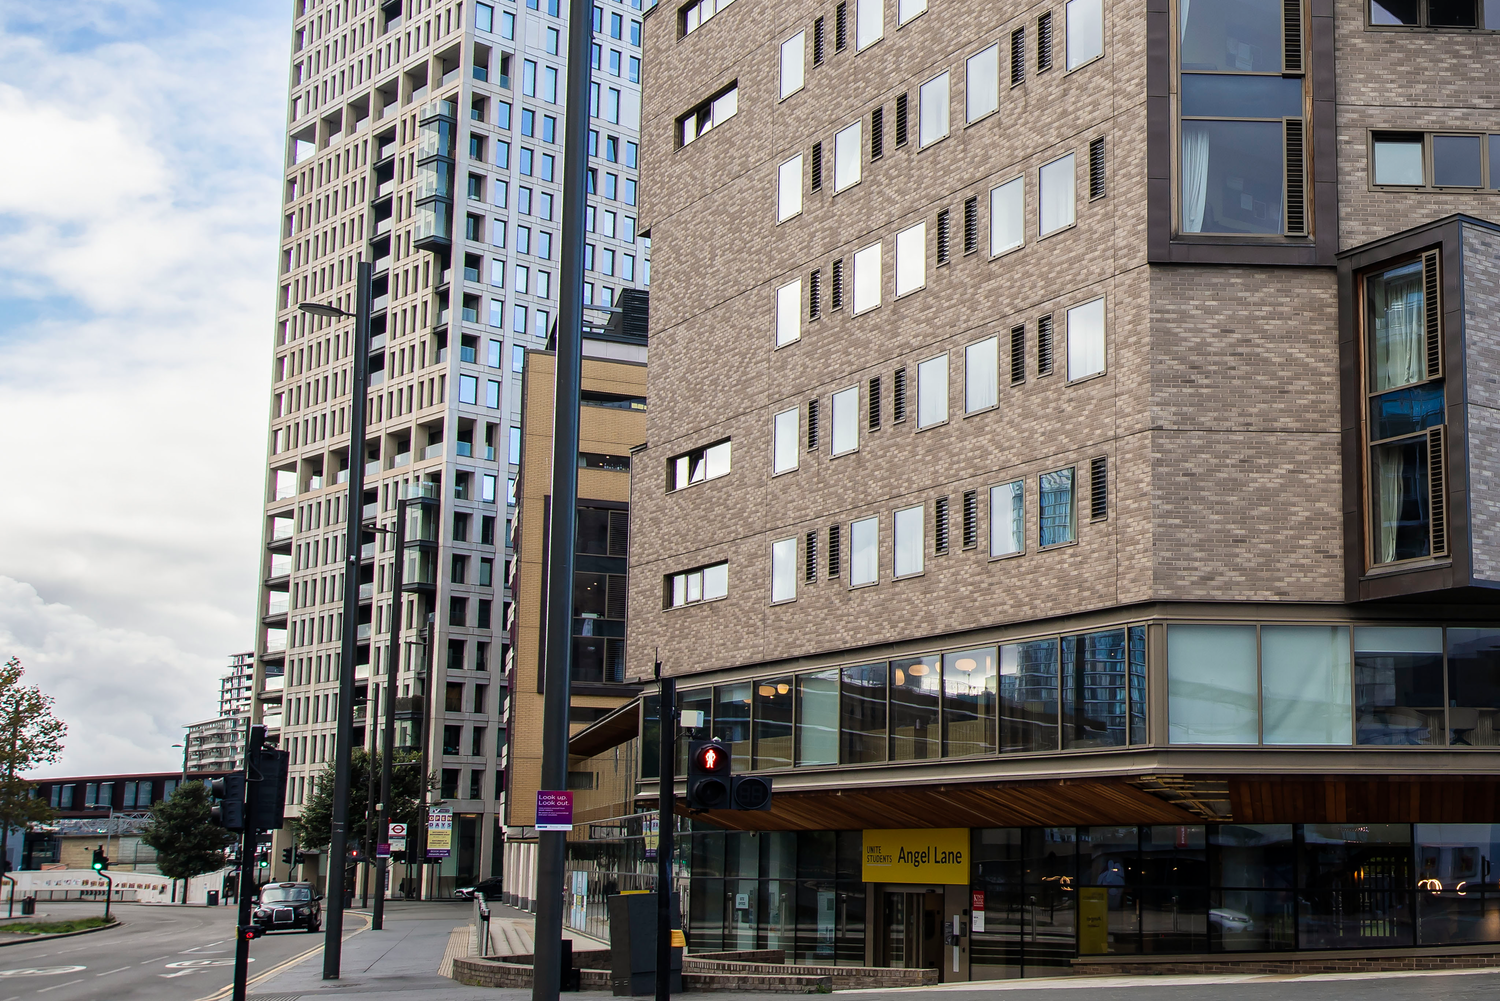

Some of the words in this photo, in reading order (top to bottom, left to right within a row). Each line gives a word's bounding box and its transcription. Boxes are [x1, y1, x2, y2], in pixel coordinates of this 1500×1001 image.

[866, 845, 882, 854] UNITE
[866, 854, 893, 863] STUDENTS
[897, 845, 931, 868] Angel
[934, 845, 963, 865] Lane
